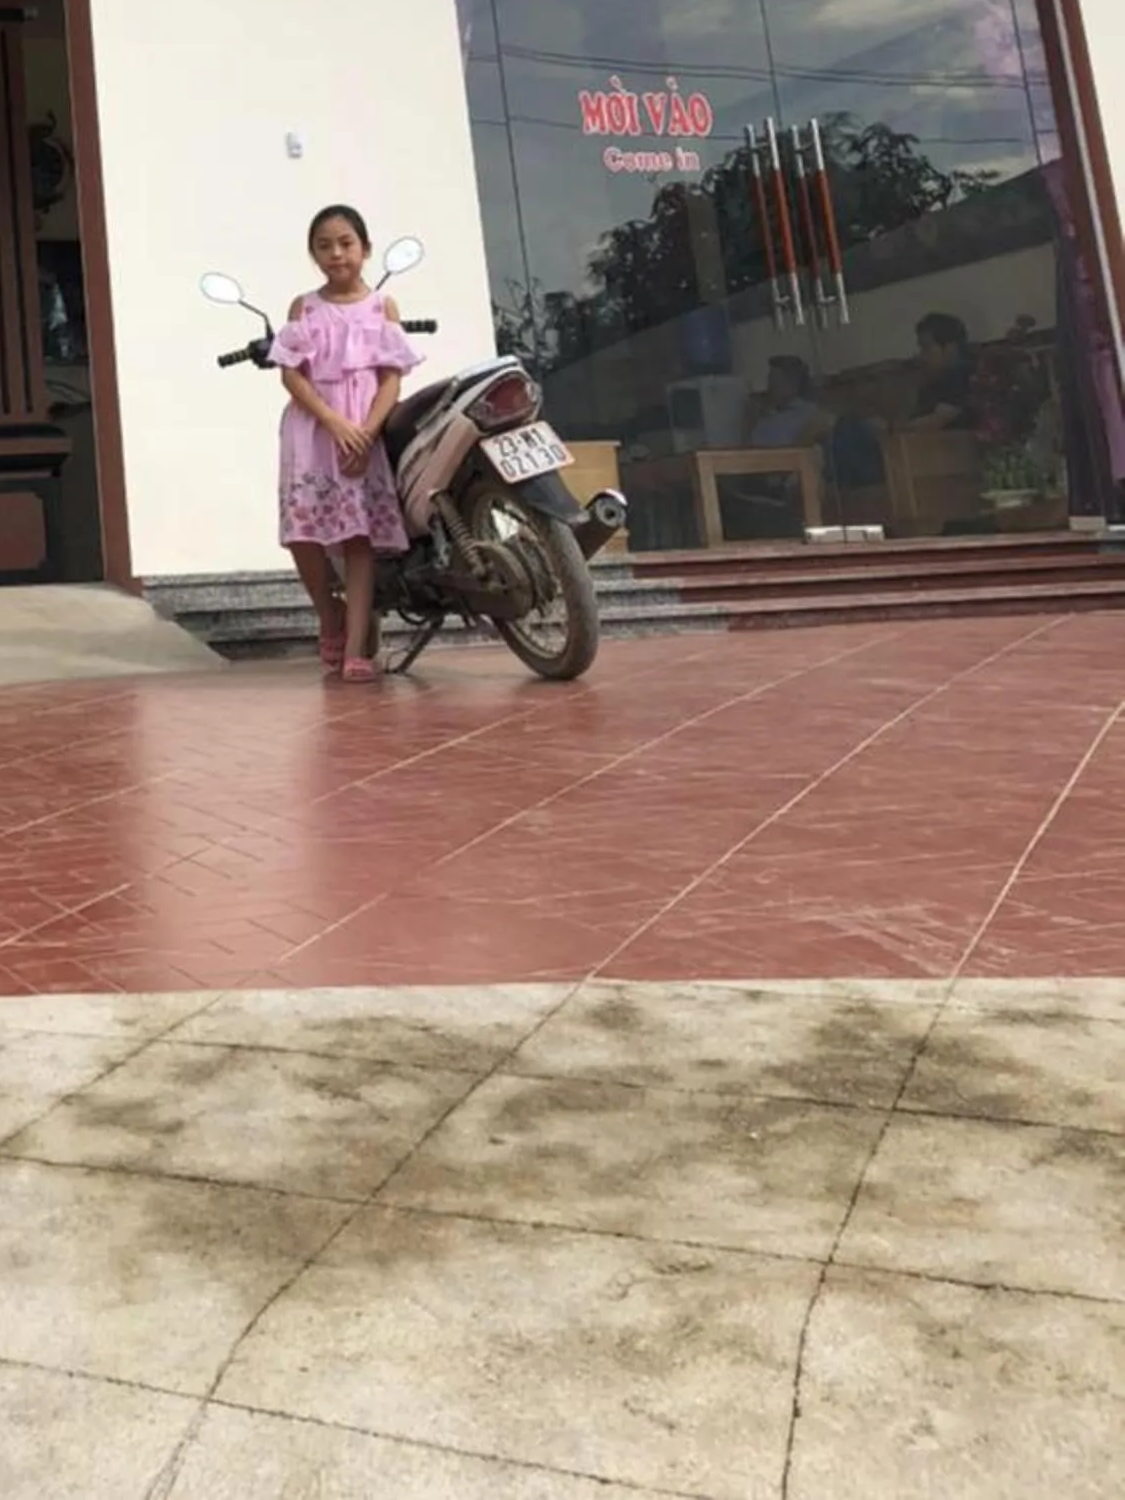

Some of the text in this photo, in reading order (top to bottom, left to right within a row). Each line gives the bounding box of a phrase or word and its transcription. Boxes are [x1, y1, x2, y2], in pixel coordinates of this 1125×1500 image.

[579, 75, 641, 136] MỜI
[603, 146, 701, 172] Come in
